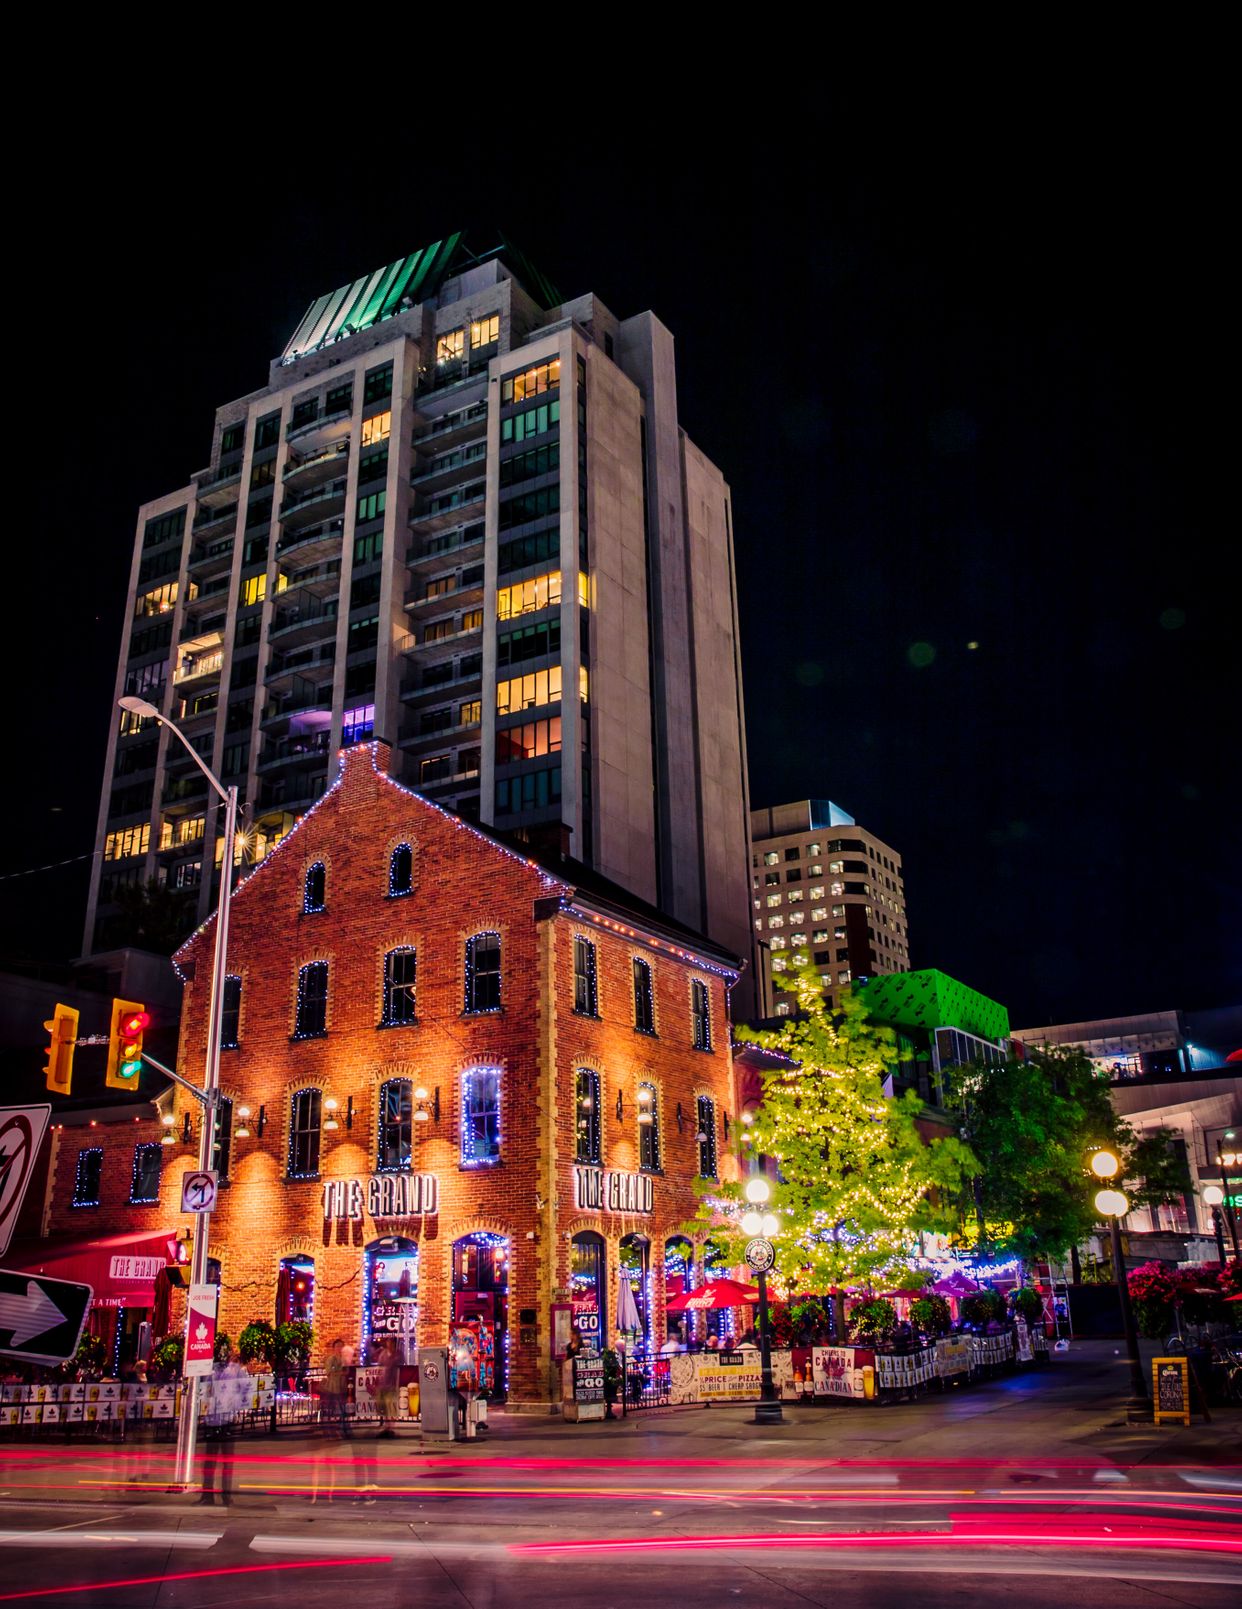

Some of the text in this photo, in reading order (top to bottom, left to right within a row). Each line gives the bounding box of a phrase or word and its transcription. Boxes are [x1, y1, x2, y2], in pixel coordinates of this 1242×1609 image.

[577, 1168, 654, 1212] THE GRAND
[323, 1174, 437, 1219] THE GRAND
[113, 1258, 130, 1276] THE
[387, 1317, 414, 1331] GO
[579, 1316, 598, 1329] GO
[576, 1359, 604, 1369] THE GRAND
[729, 1355, 743, 1363] GRAND
[816, 1357, 852, 1368] CANADA
[585, 1378, 604, 1388] GO
[705, 1375, 727, 1383] PRICE
[708, 1382, 720, 1391] BEER
[729, 1381, 744, 1390] CHEAP
[815, 1381, 852, 1393] CANADIAN
